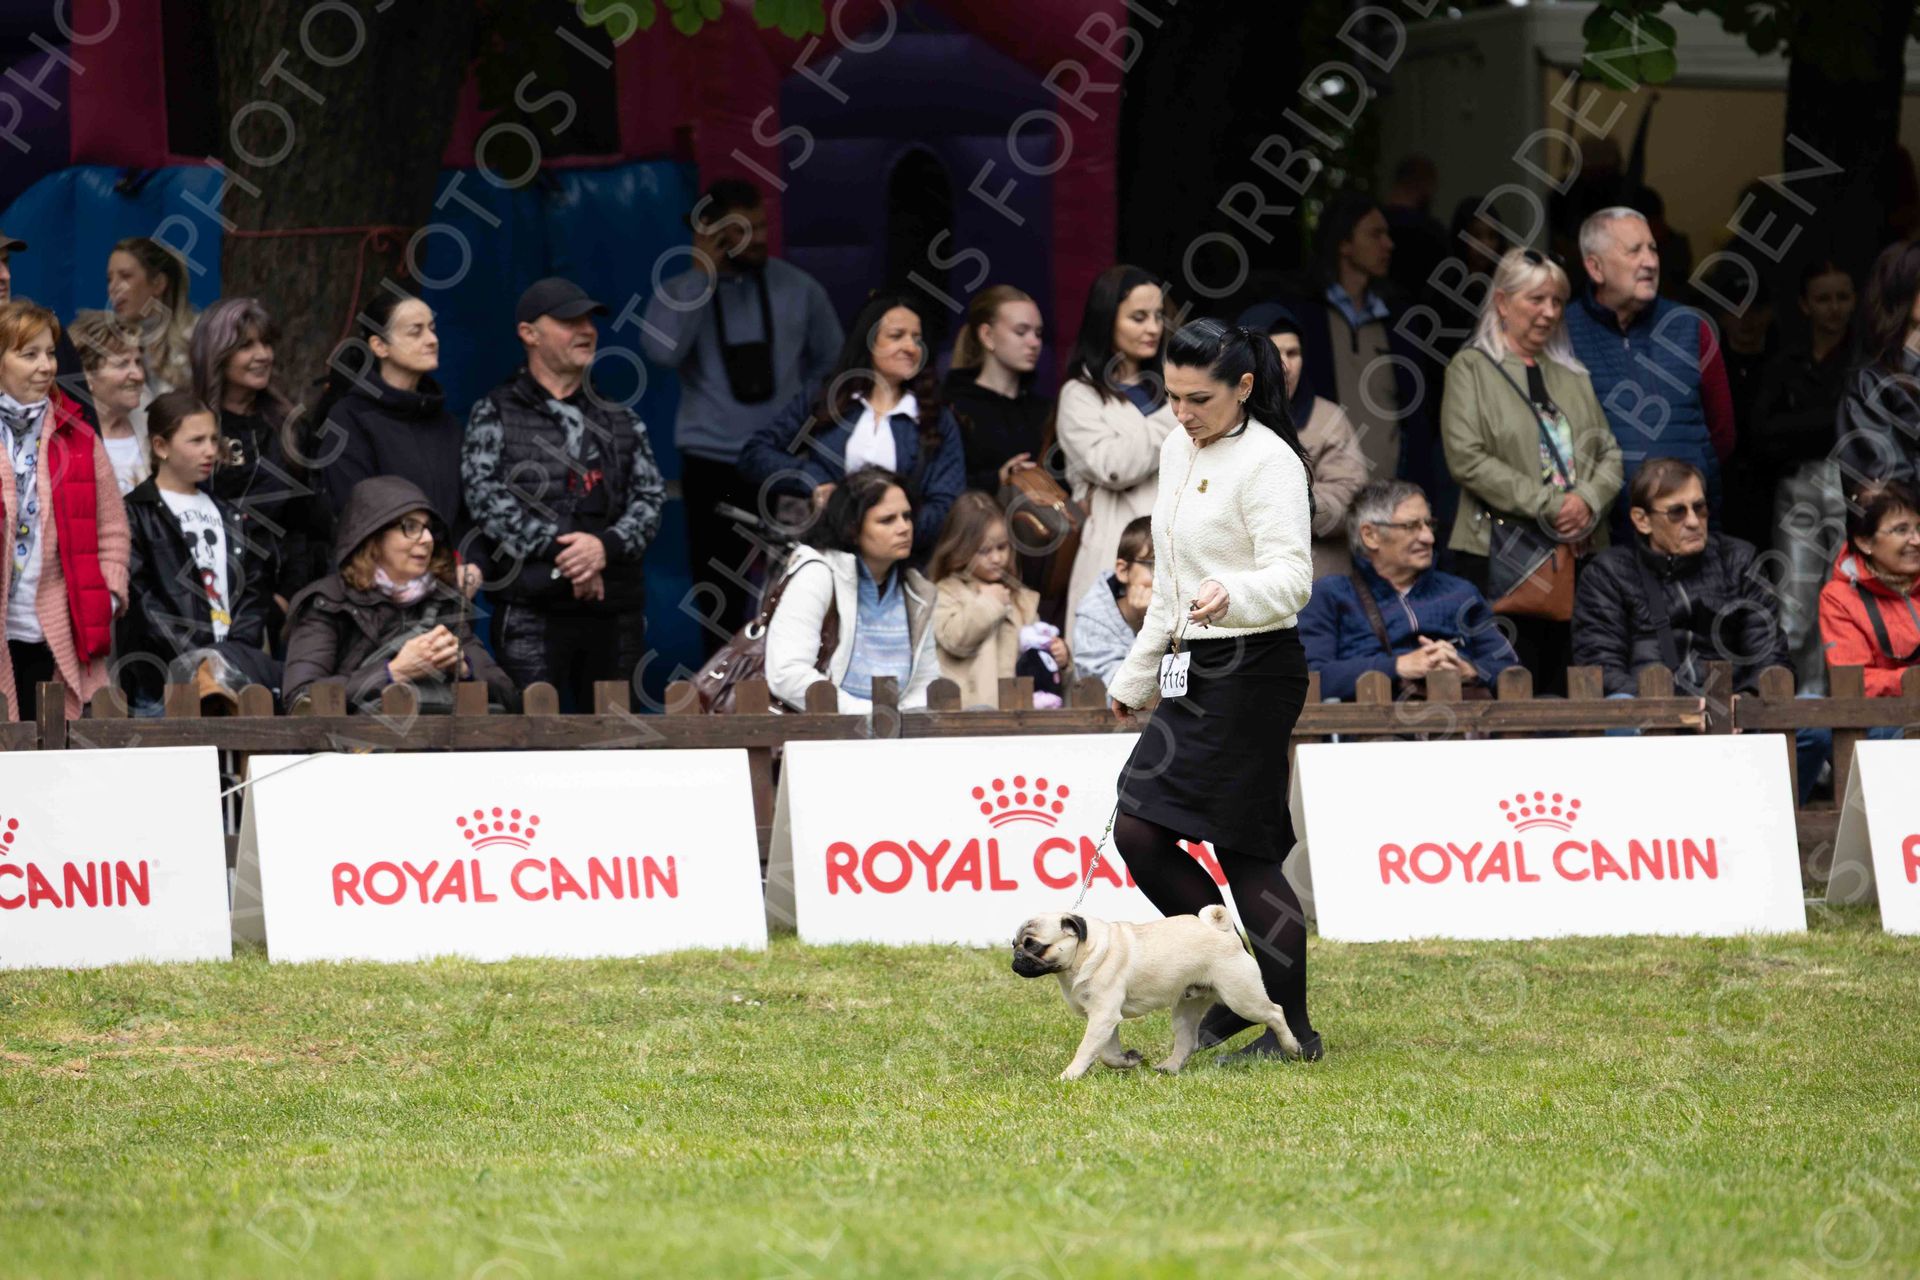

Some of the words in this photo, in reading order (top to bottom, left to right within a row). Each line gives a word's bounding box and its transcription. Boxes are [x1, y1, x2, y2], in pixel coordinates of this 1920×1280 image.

[1162, 669, 1186, 690] 1116
[0, 860, 150, 910] CANIN
[332, 859, 498, 906] ROYAL
[511, 856, 678, 901] CANIN
[826, 838, 1018, 895] ROYAL
[1379, 841, 1540, 884] ROYAL
[1553, 838, 1718, 881] CANIN
